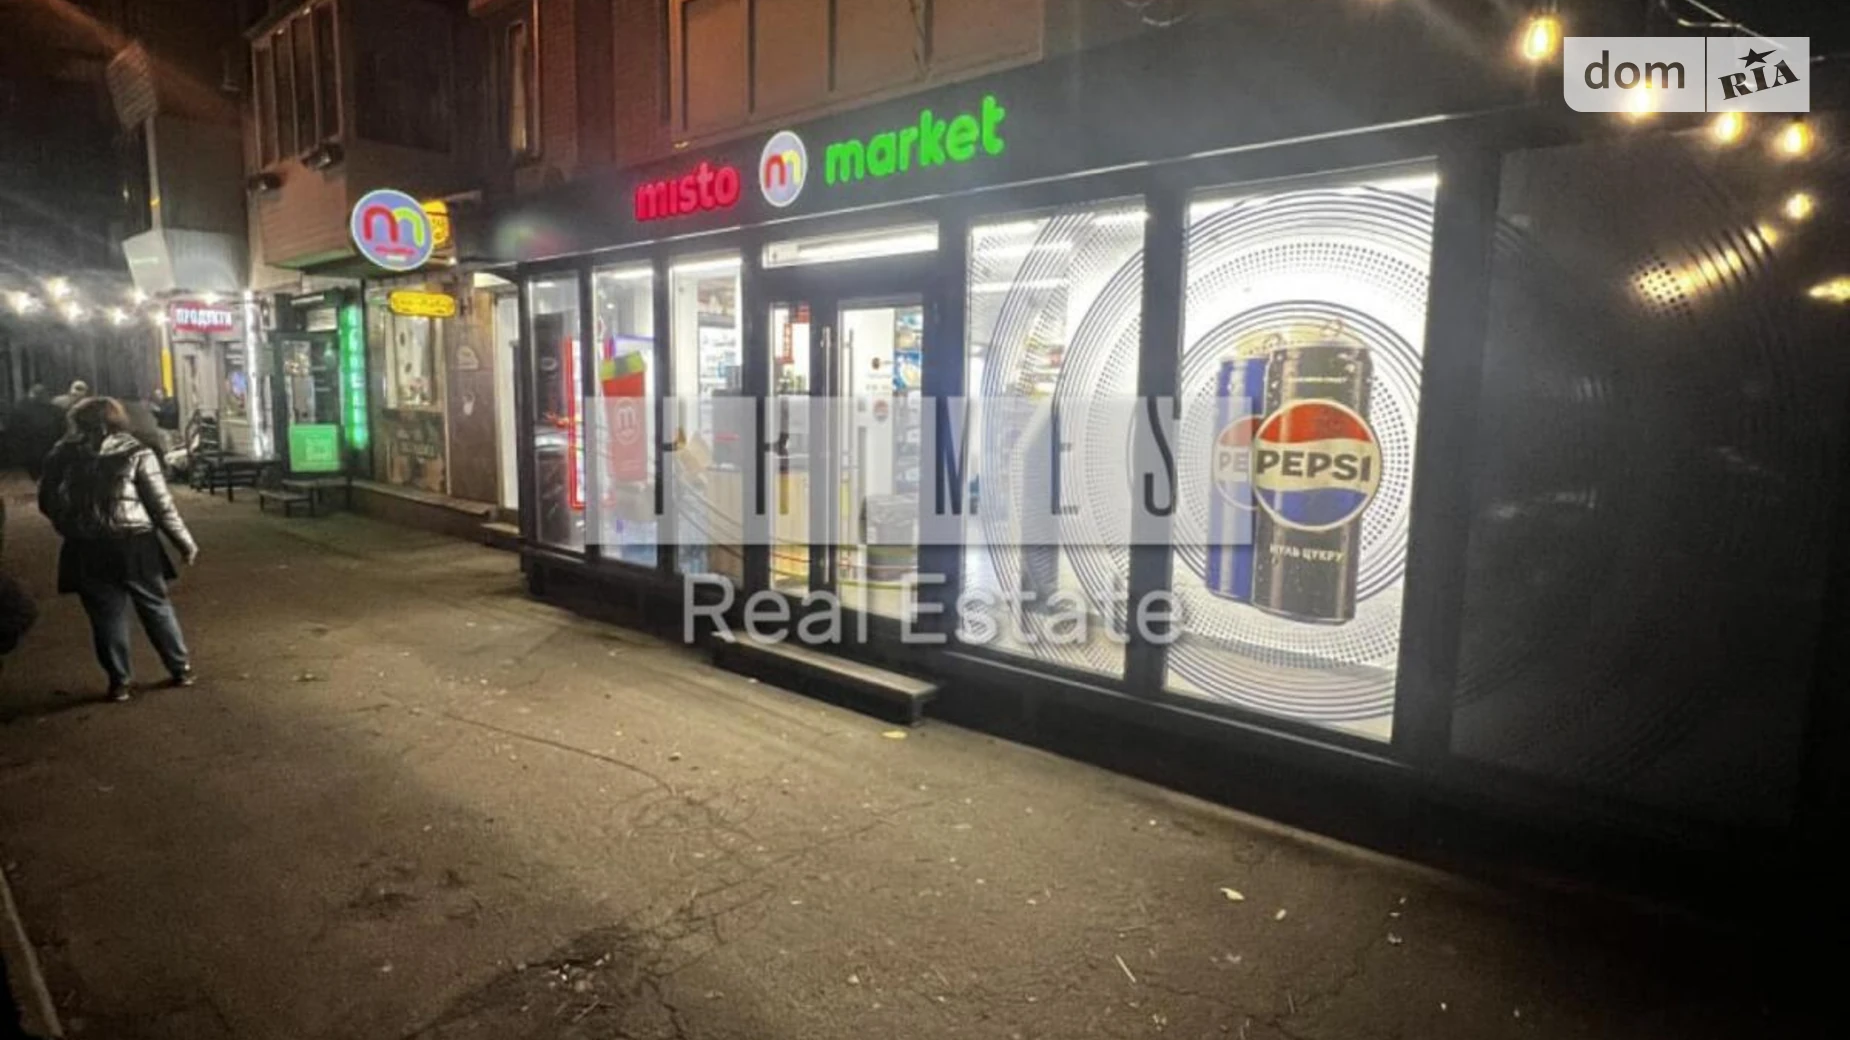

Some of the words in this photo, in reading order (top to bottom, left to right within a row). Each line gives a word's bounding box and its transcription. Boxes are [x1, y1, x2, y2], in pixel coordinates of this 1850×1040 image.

[635, 161, 741, 222] misto
[824, 95, 1005, 185] market
[1256, 450, 1372, 482] PEPSI
